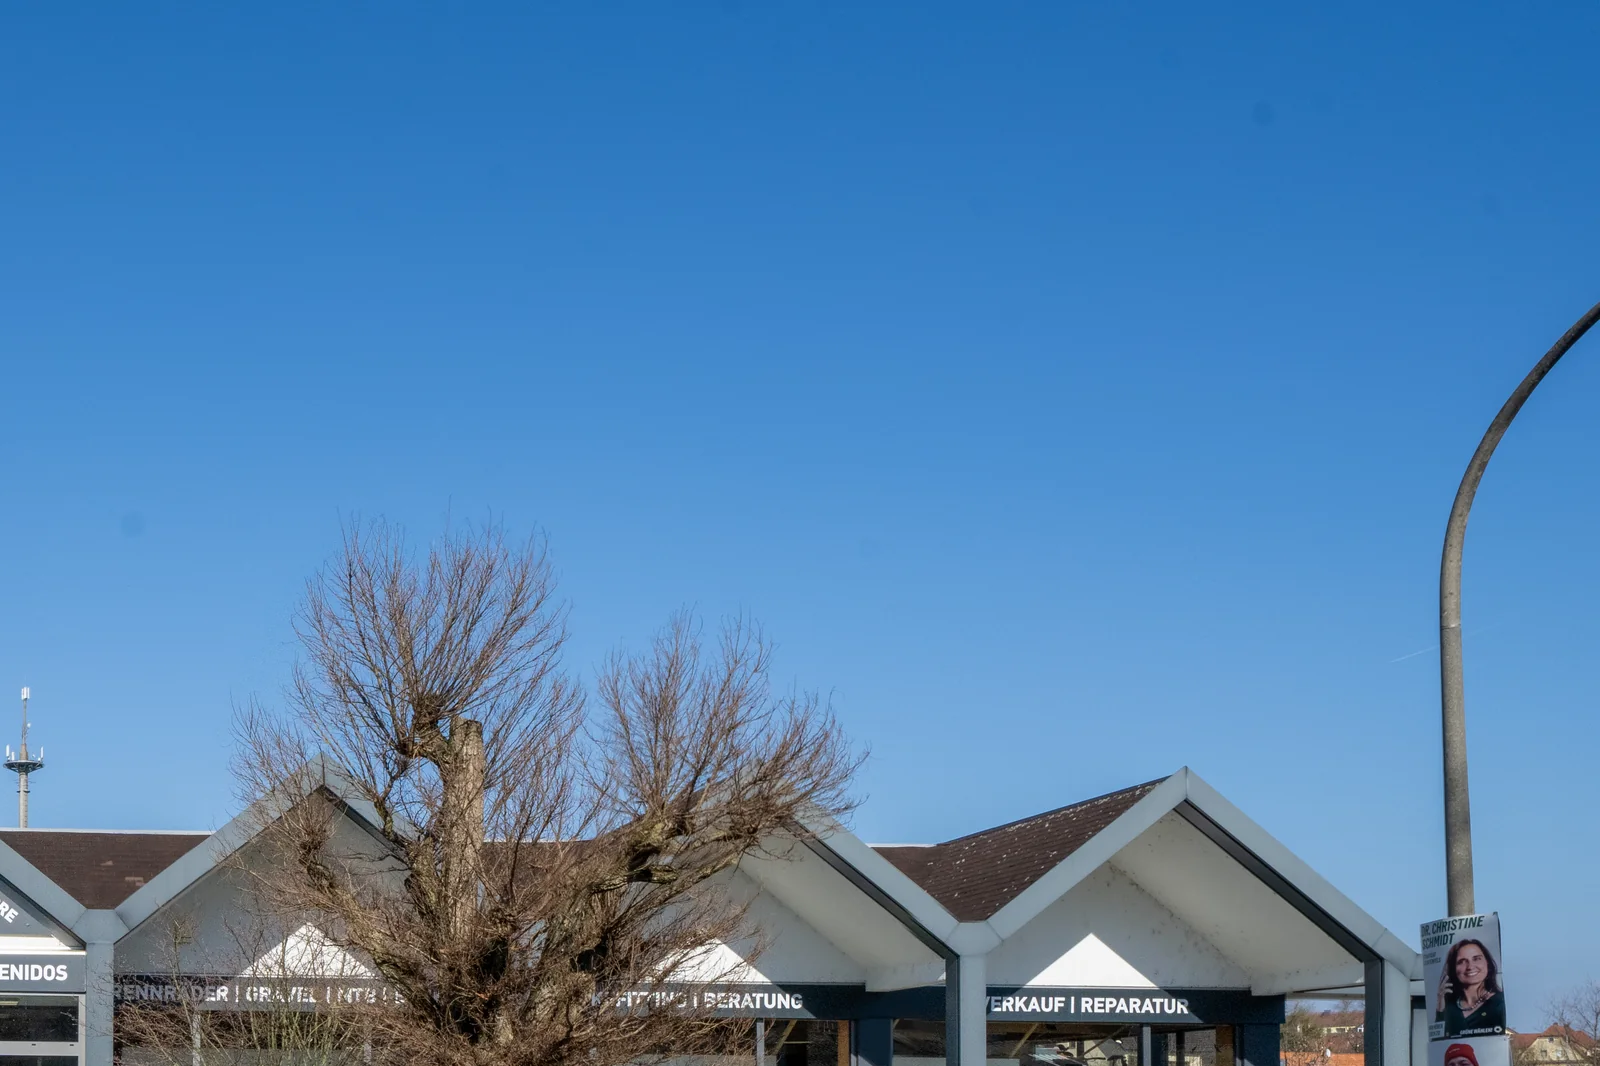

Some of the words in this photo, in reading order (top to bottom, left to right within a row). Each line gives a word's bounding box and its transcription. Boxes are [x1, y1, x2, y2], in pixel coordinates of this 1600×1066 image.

[1431, 915, 1485, 934] CHRISTINE
[1422, 933, 1455, 949] SCHMIDT
[704, 992, 803, 1009] BERATUNG
[1081, 997, 1189, 1014] REPARATUR
